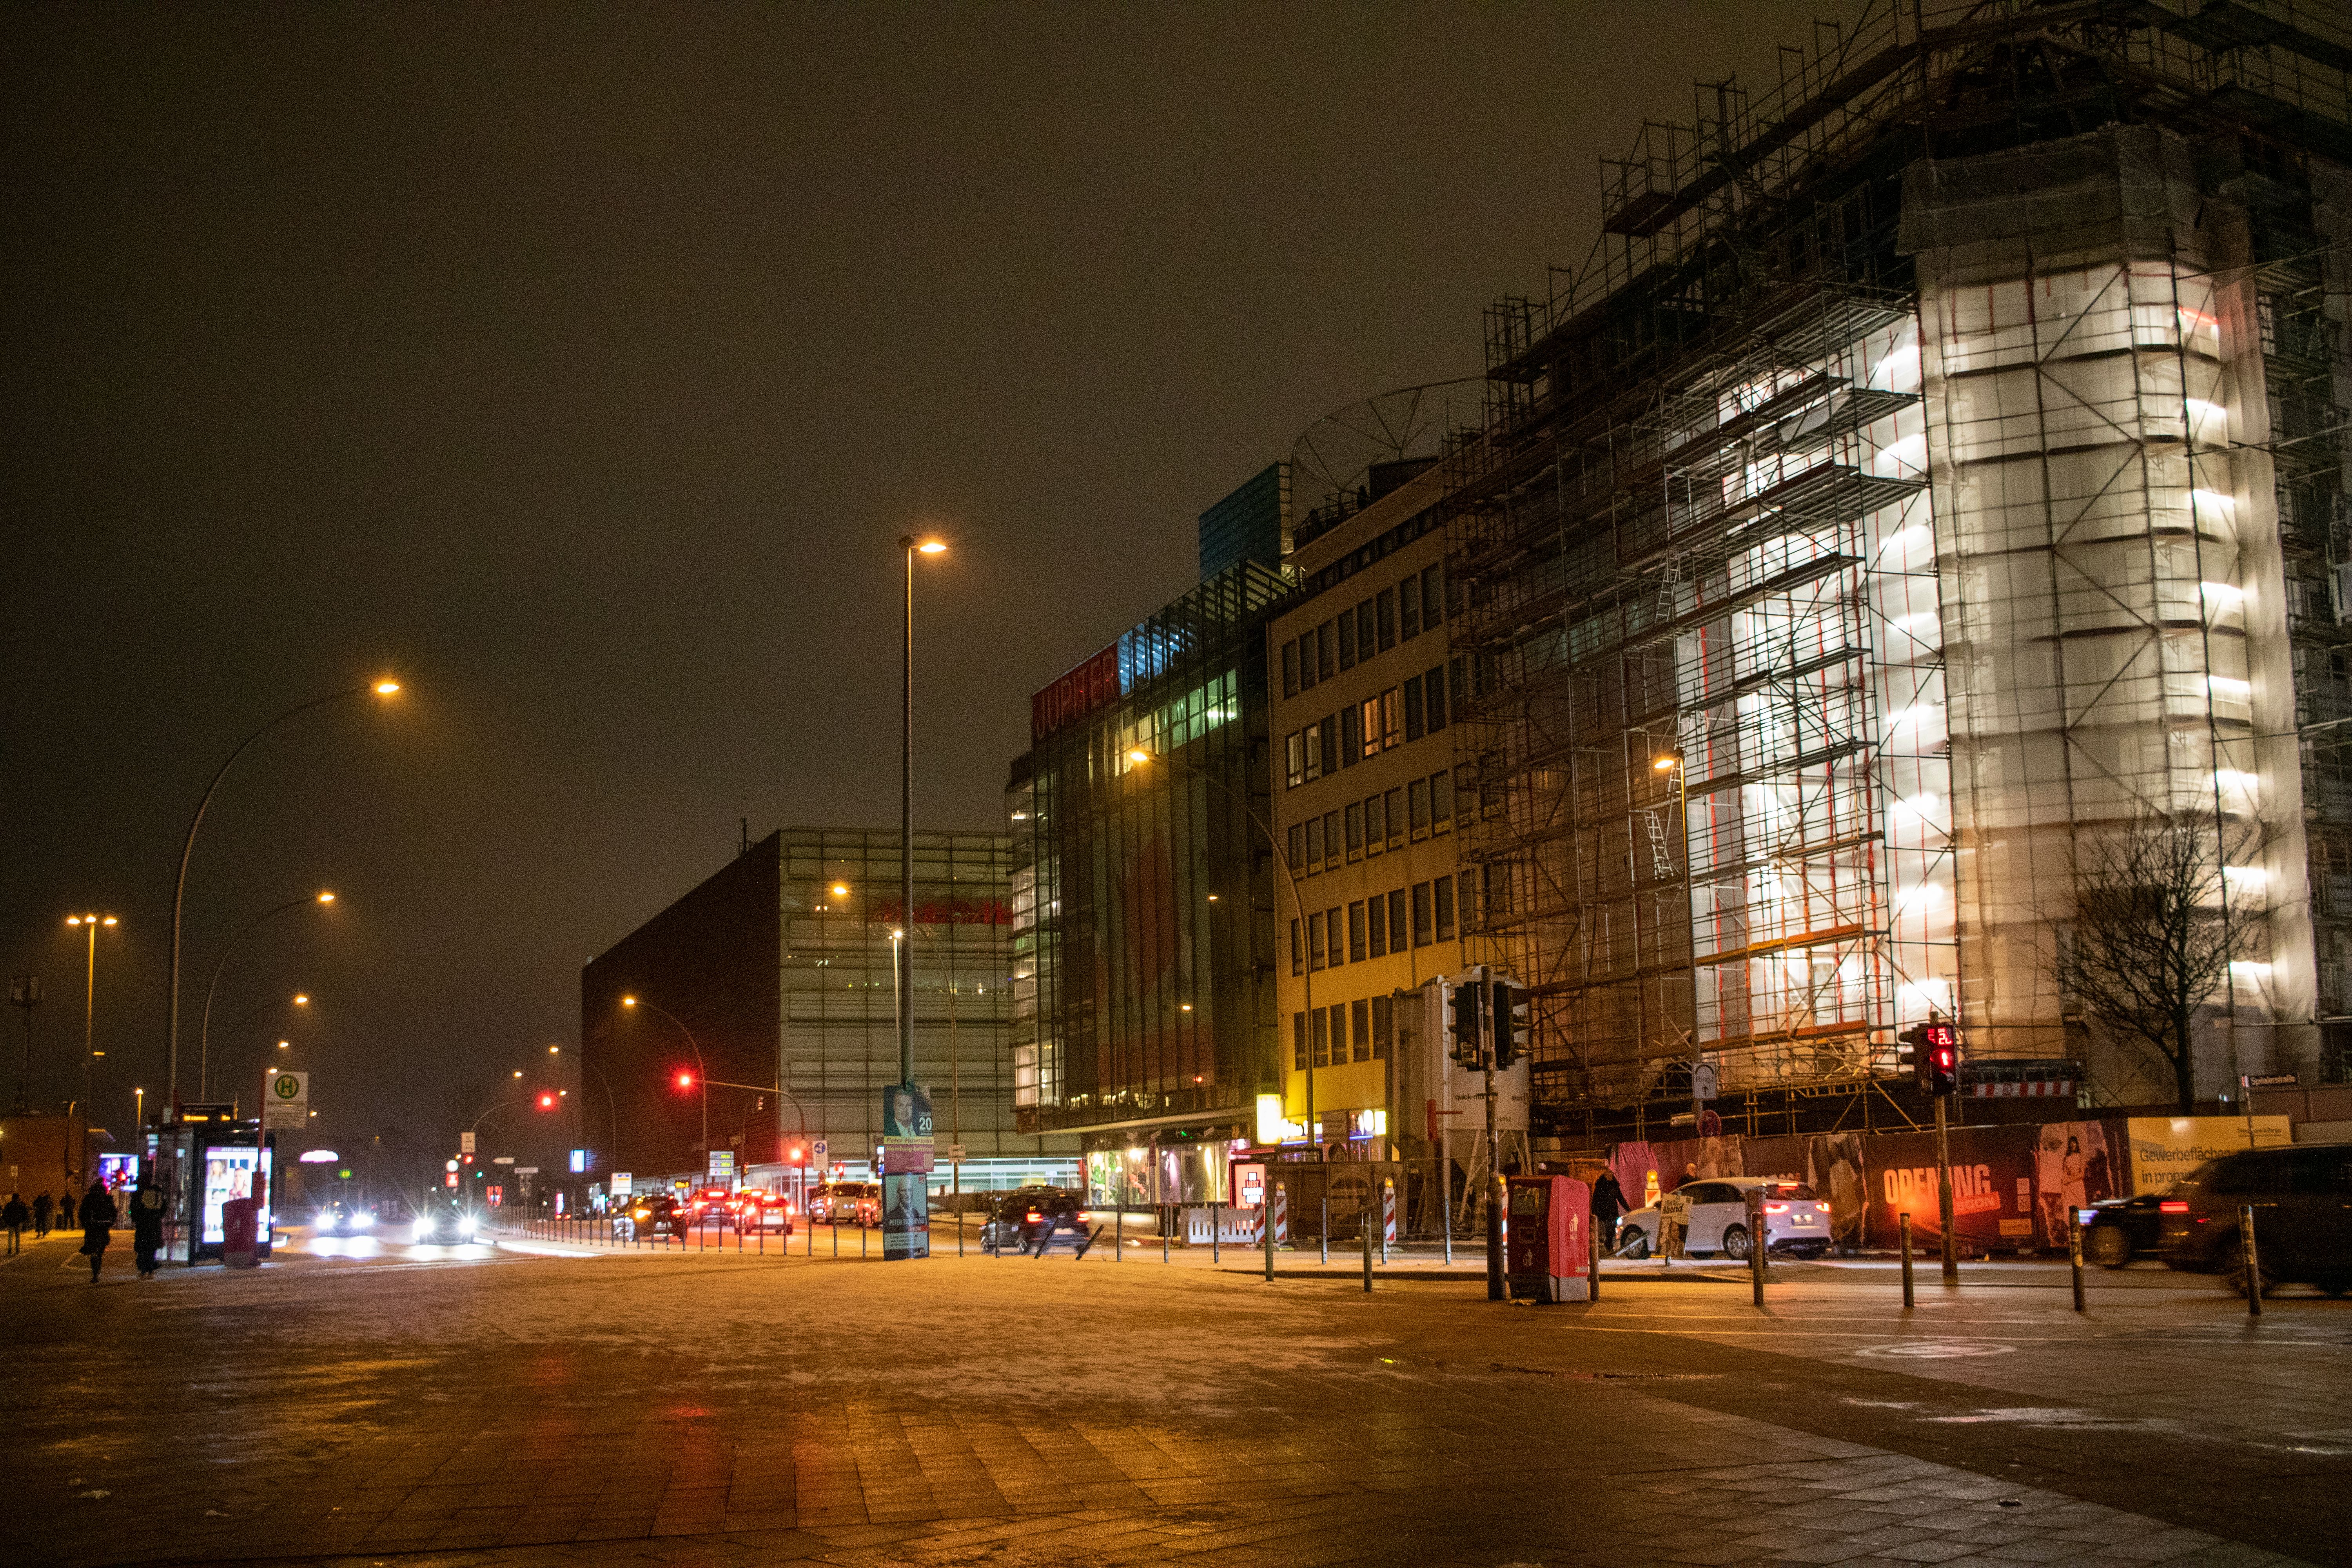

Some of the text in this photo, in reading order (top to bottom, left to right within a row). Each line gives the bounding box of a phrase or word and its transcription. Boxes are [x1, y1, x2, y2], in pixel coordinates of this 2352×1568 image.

[1036, 652, 1116, 740] JUPITER
[281, 1079, 293, 1093] H
[919, 1117, 932, 1131] 20
[2141, 1170, 2153, 1183] in
[1662, 1203, 1684, 1214] Abend
[1956, 1196, 1995, 1212] SOON
